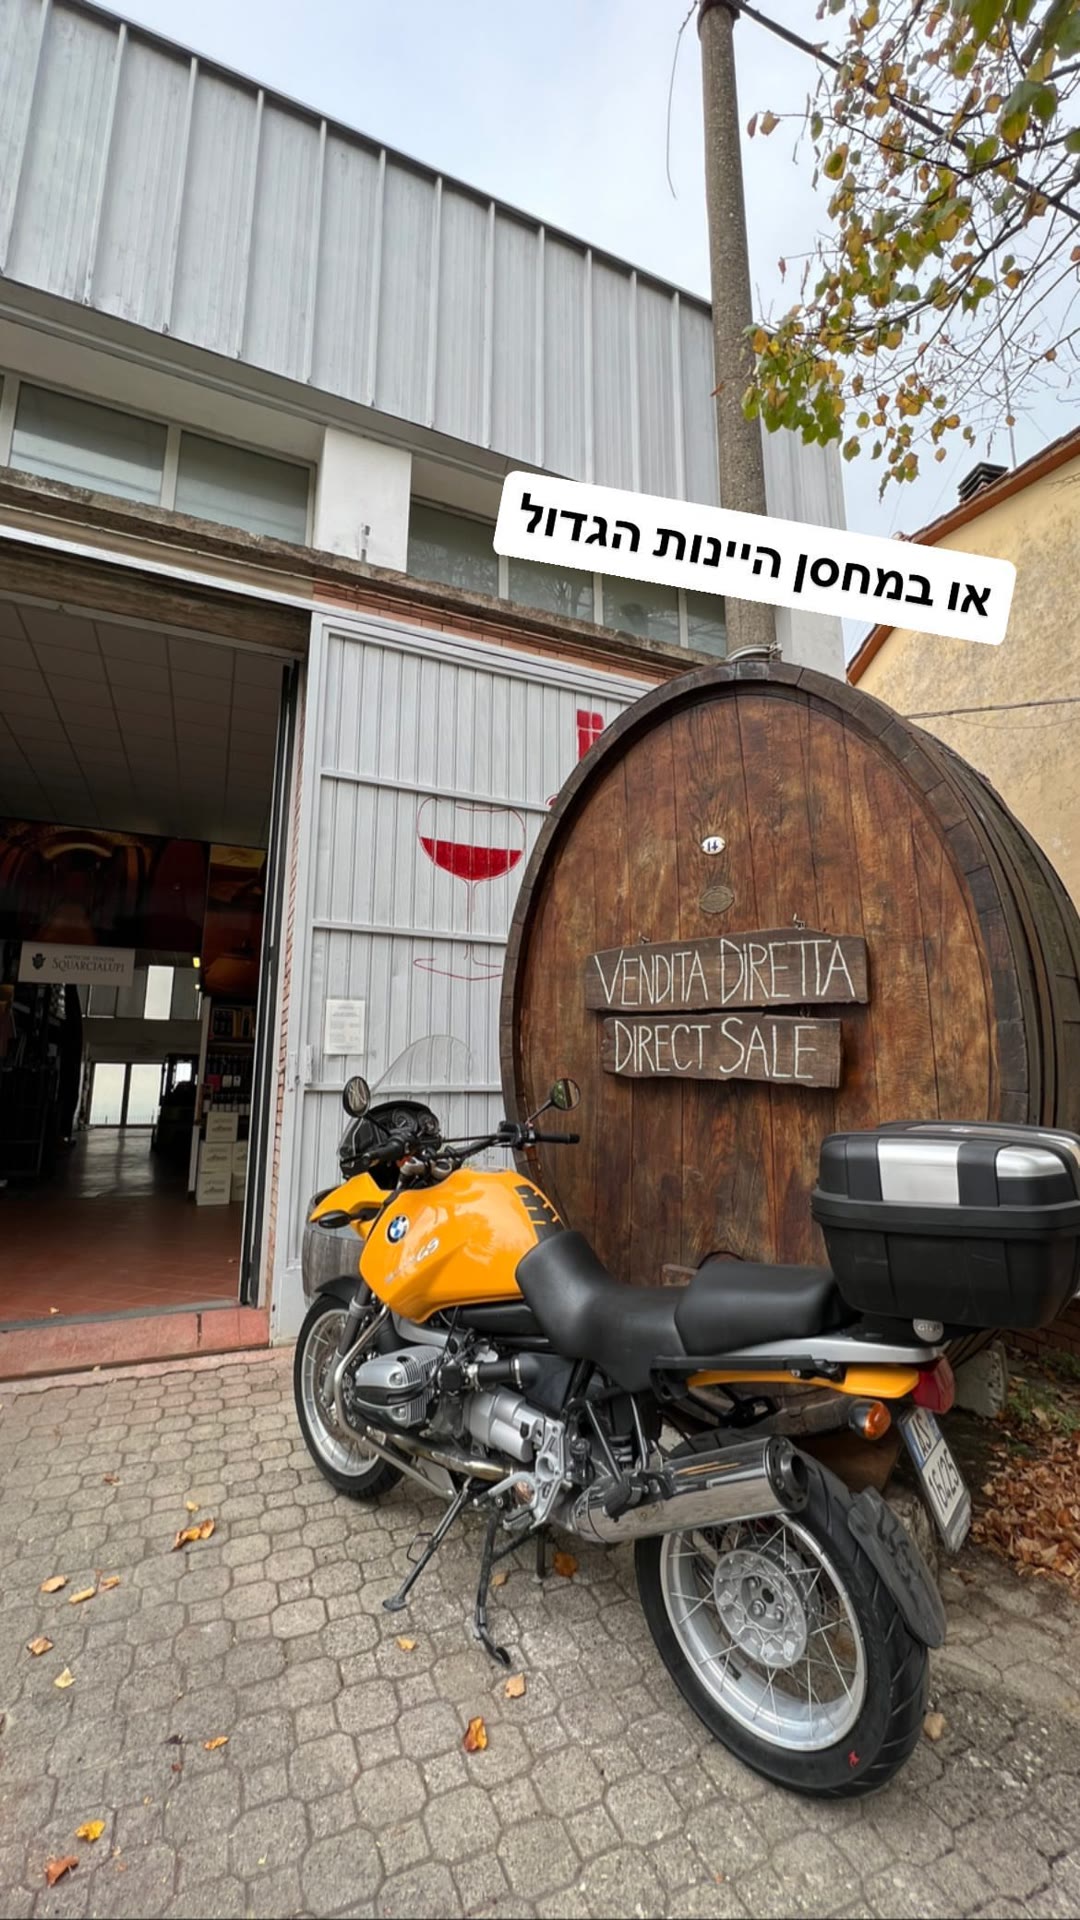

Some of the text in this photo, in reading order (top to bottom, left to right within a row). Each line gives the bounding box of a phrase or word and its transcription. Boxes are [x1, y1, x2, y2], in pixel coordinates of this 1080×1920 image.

[51, 957, 125, 974] SQUARCIALUPI
[594, 938, 856, 1006] VENDITA DIRETTA
[614, 1017, 818, 1080] DIRECT SALE
